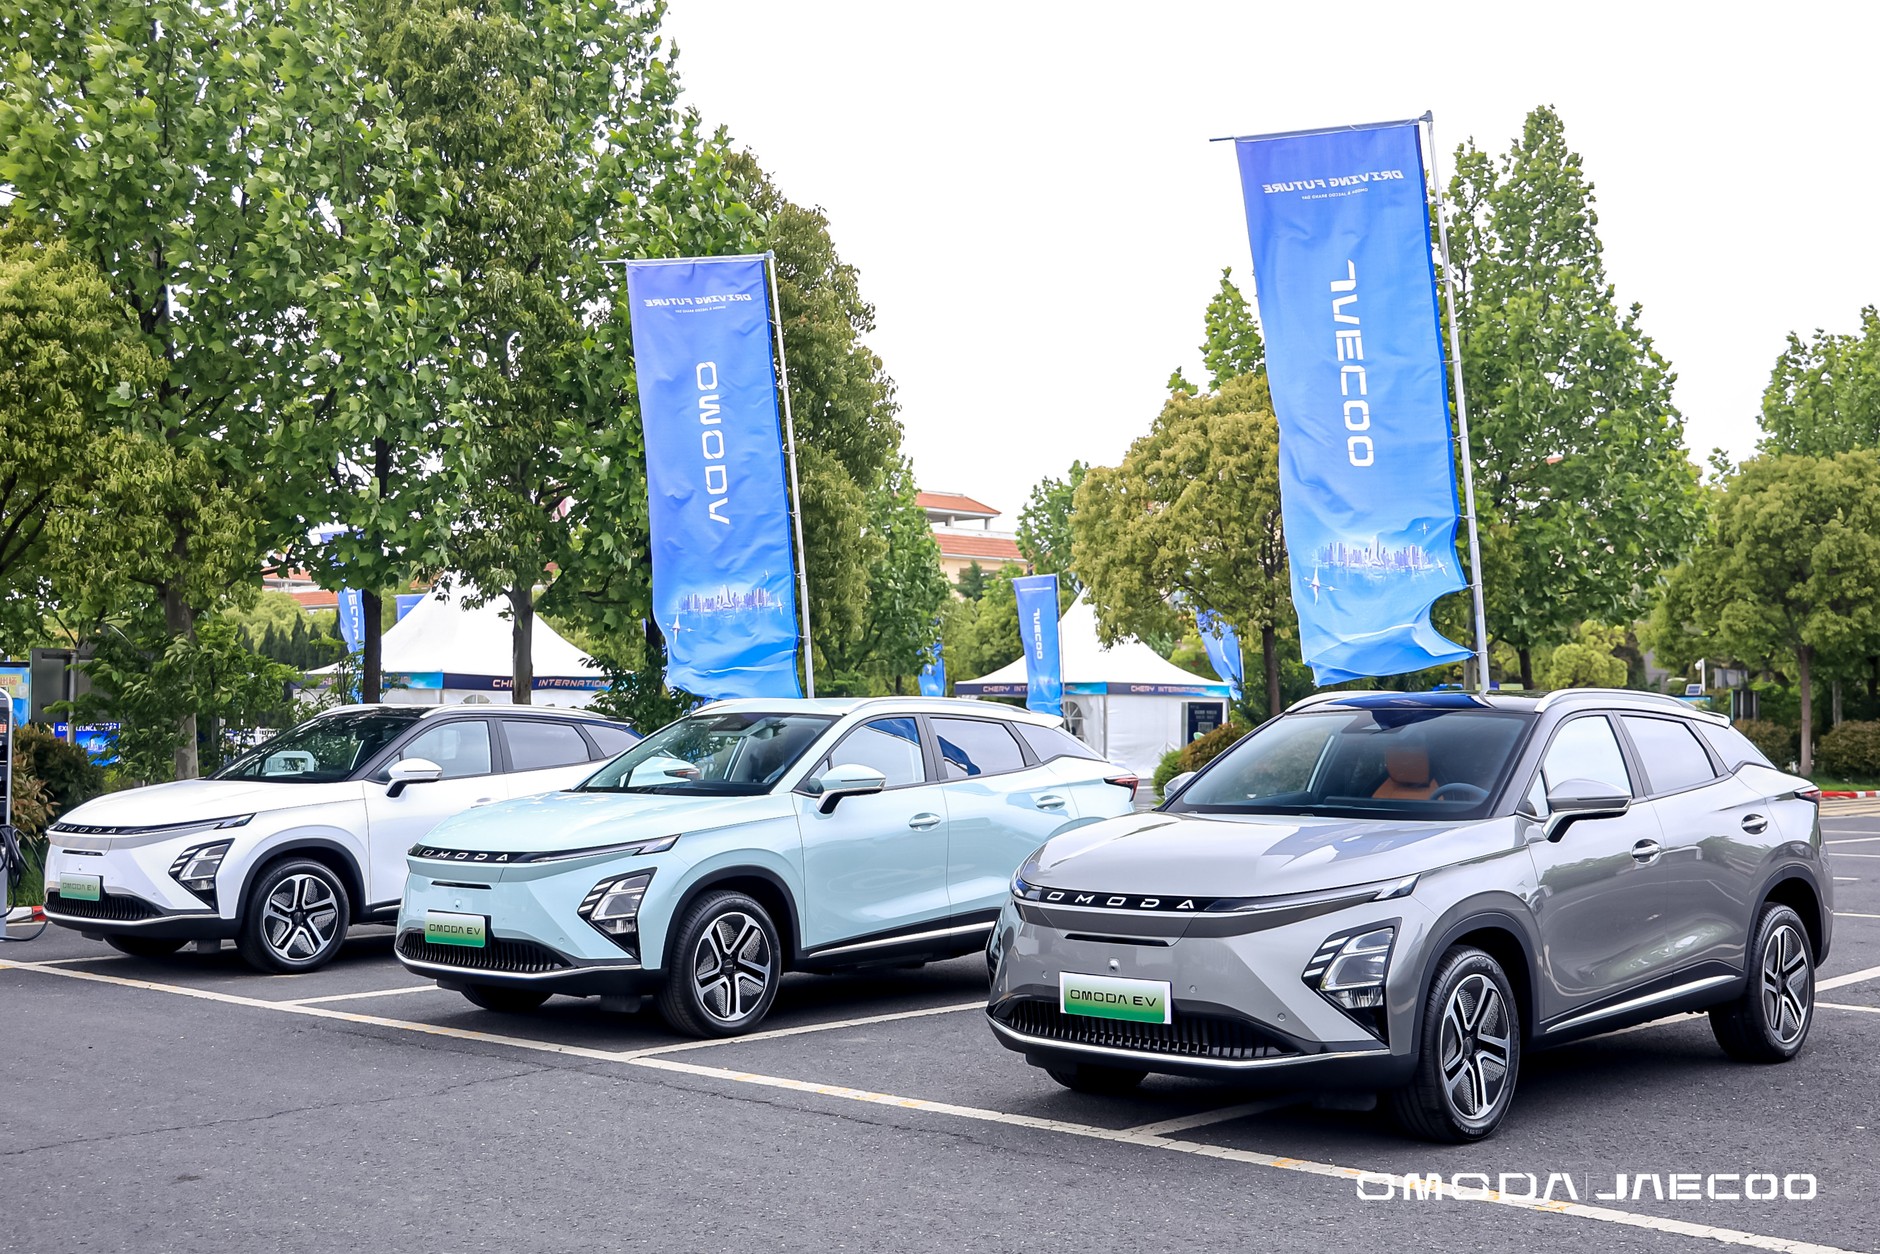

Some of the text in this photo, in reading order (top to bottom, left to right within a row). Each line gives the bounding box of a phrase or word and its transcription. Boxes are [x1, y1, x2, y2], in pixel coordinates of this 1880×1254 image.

[982, 685, 1010, 693] CHERY
[57, 823, 117, 834] OMODA
[422, 849, 509, 861] OMODA
[62, 882, 97, 892] OMODA EV
[1046, 891, 1195, 909] OMODA
[429, 923, 481, 935] OMODA EV
[1070, 989, 1157, 1007] OMODA EV
